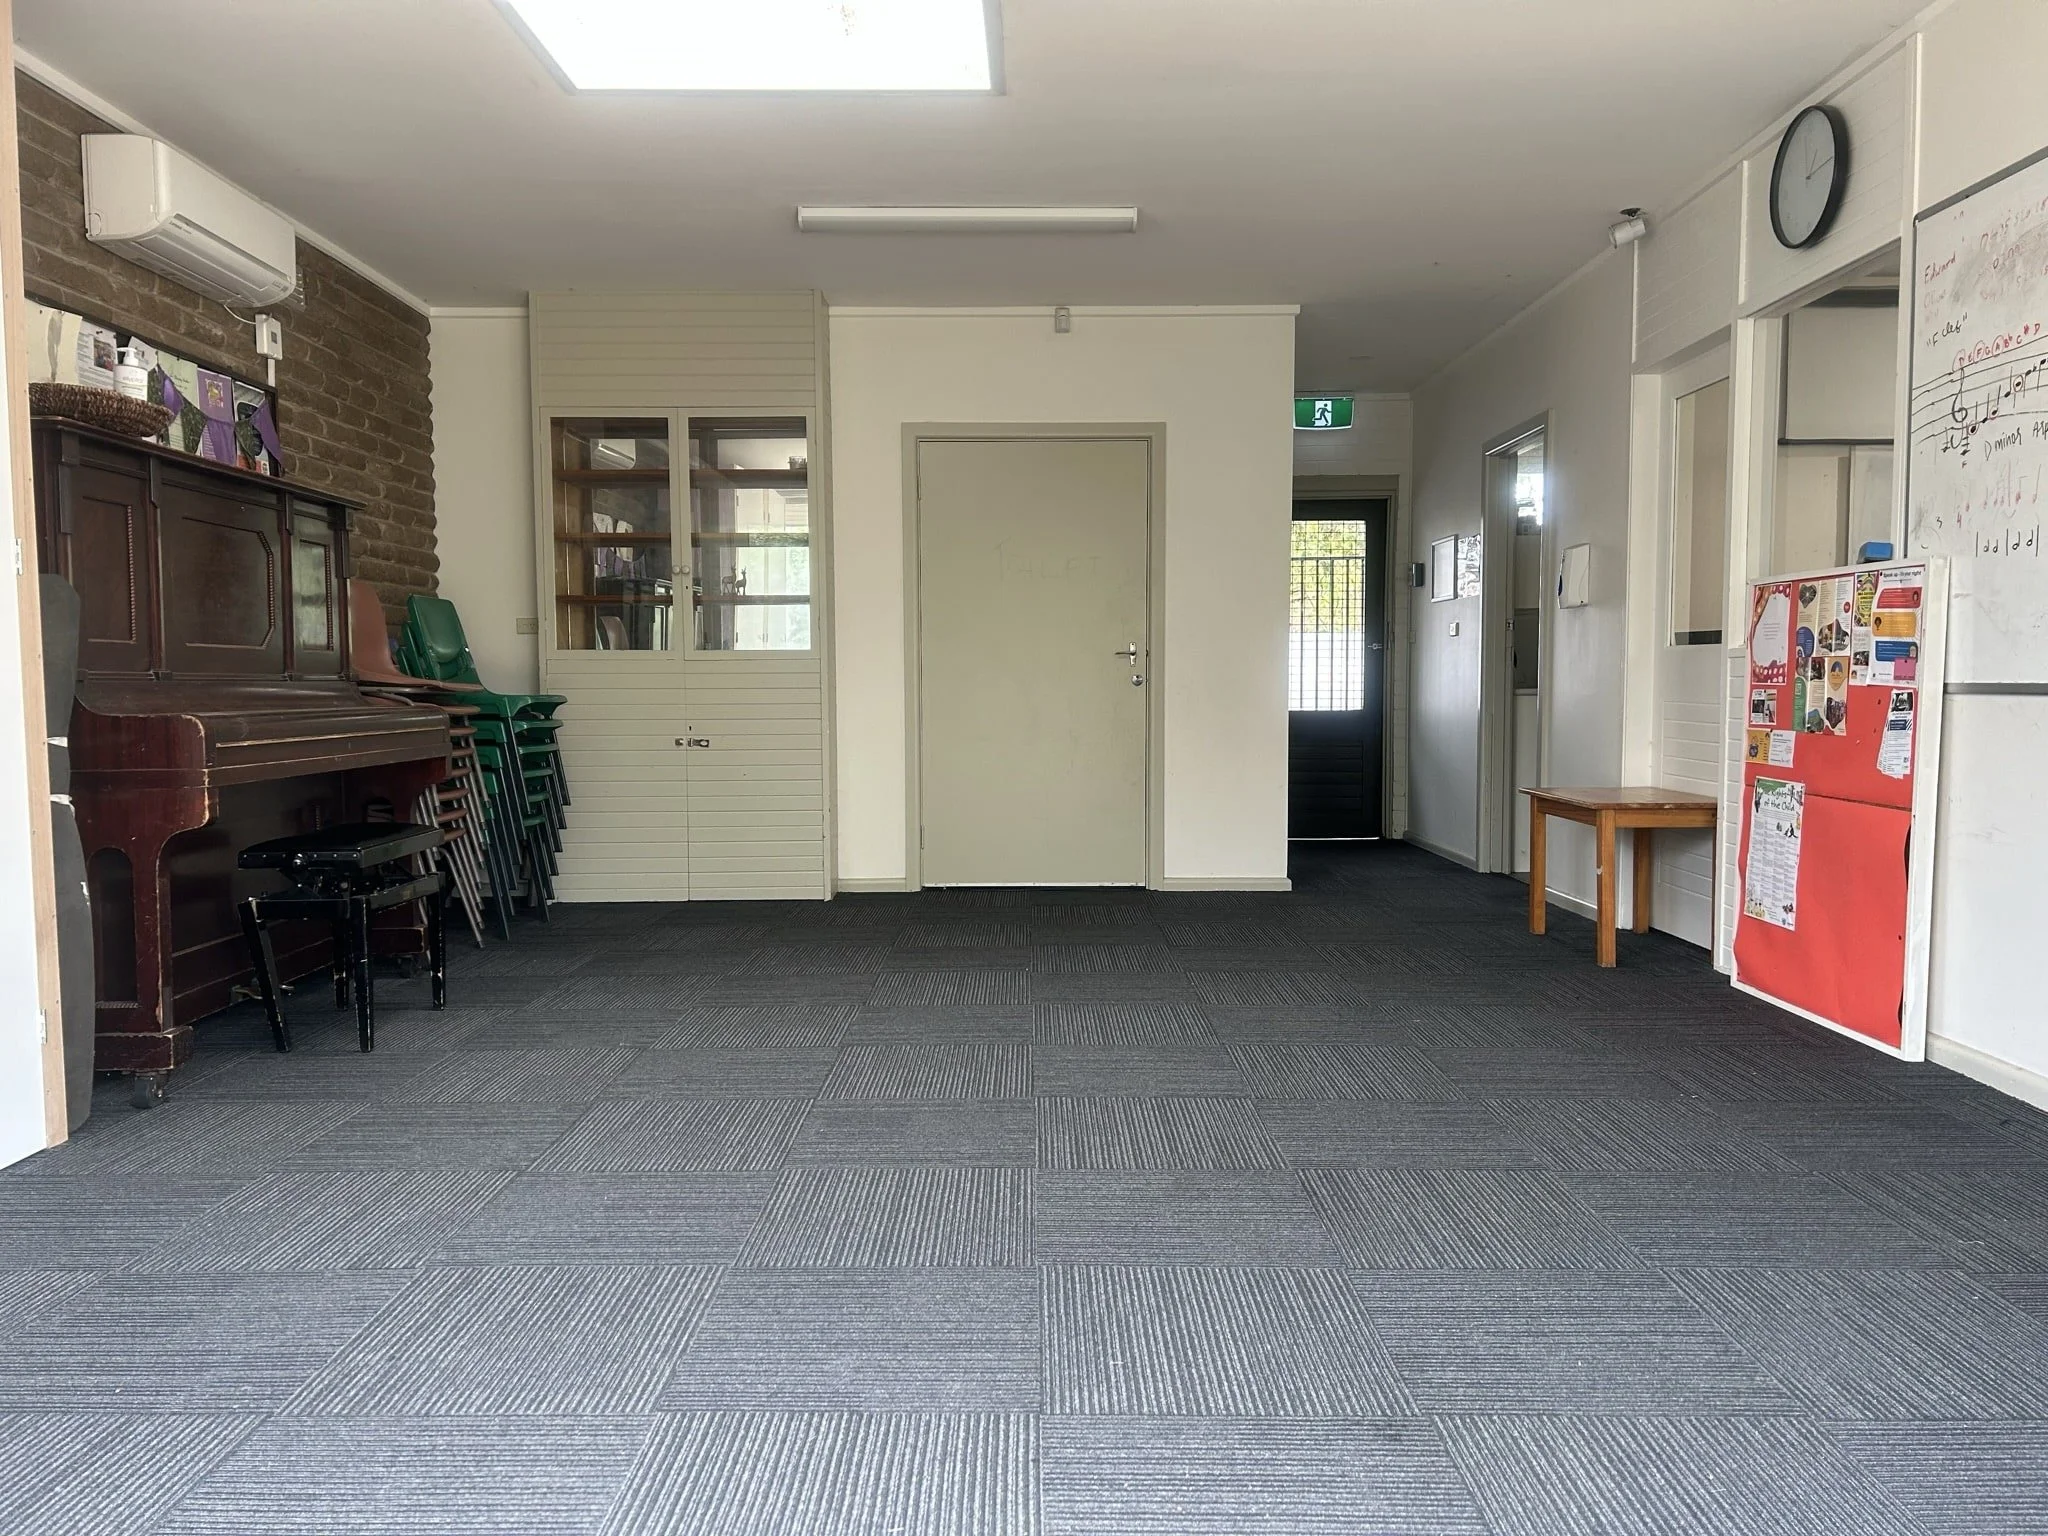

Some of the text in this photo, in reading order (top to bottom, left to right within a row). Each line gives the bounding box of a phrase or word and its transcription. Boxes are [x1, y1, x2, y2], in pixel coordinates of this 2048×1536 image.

[1924, 251, 1955, 284] Edward
[1984, 440, 1993, 461] D
[1995, 427, 2022, 452] minor
